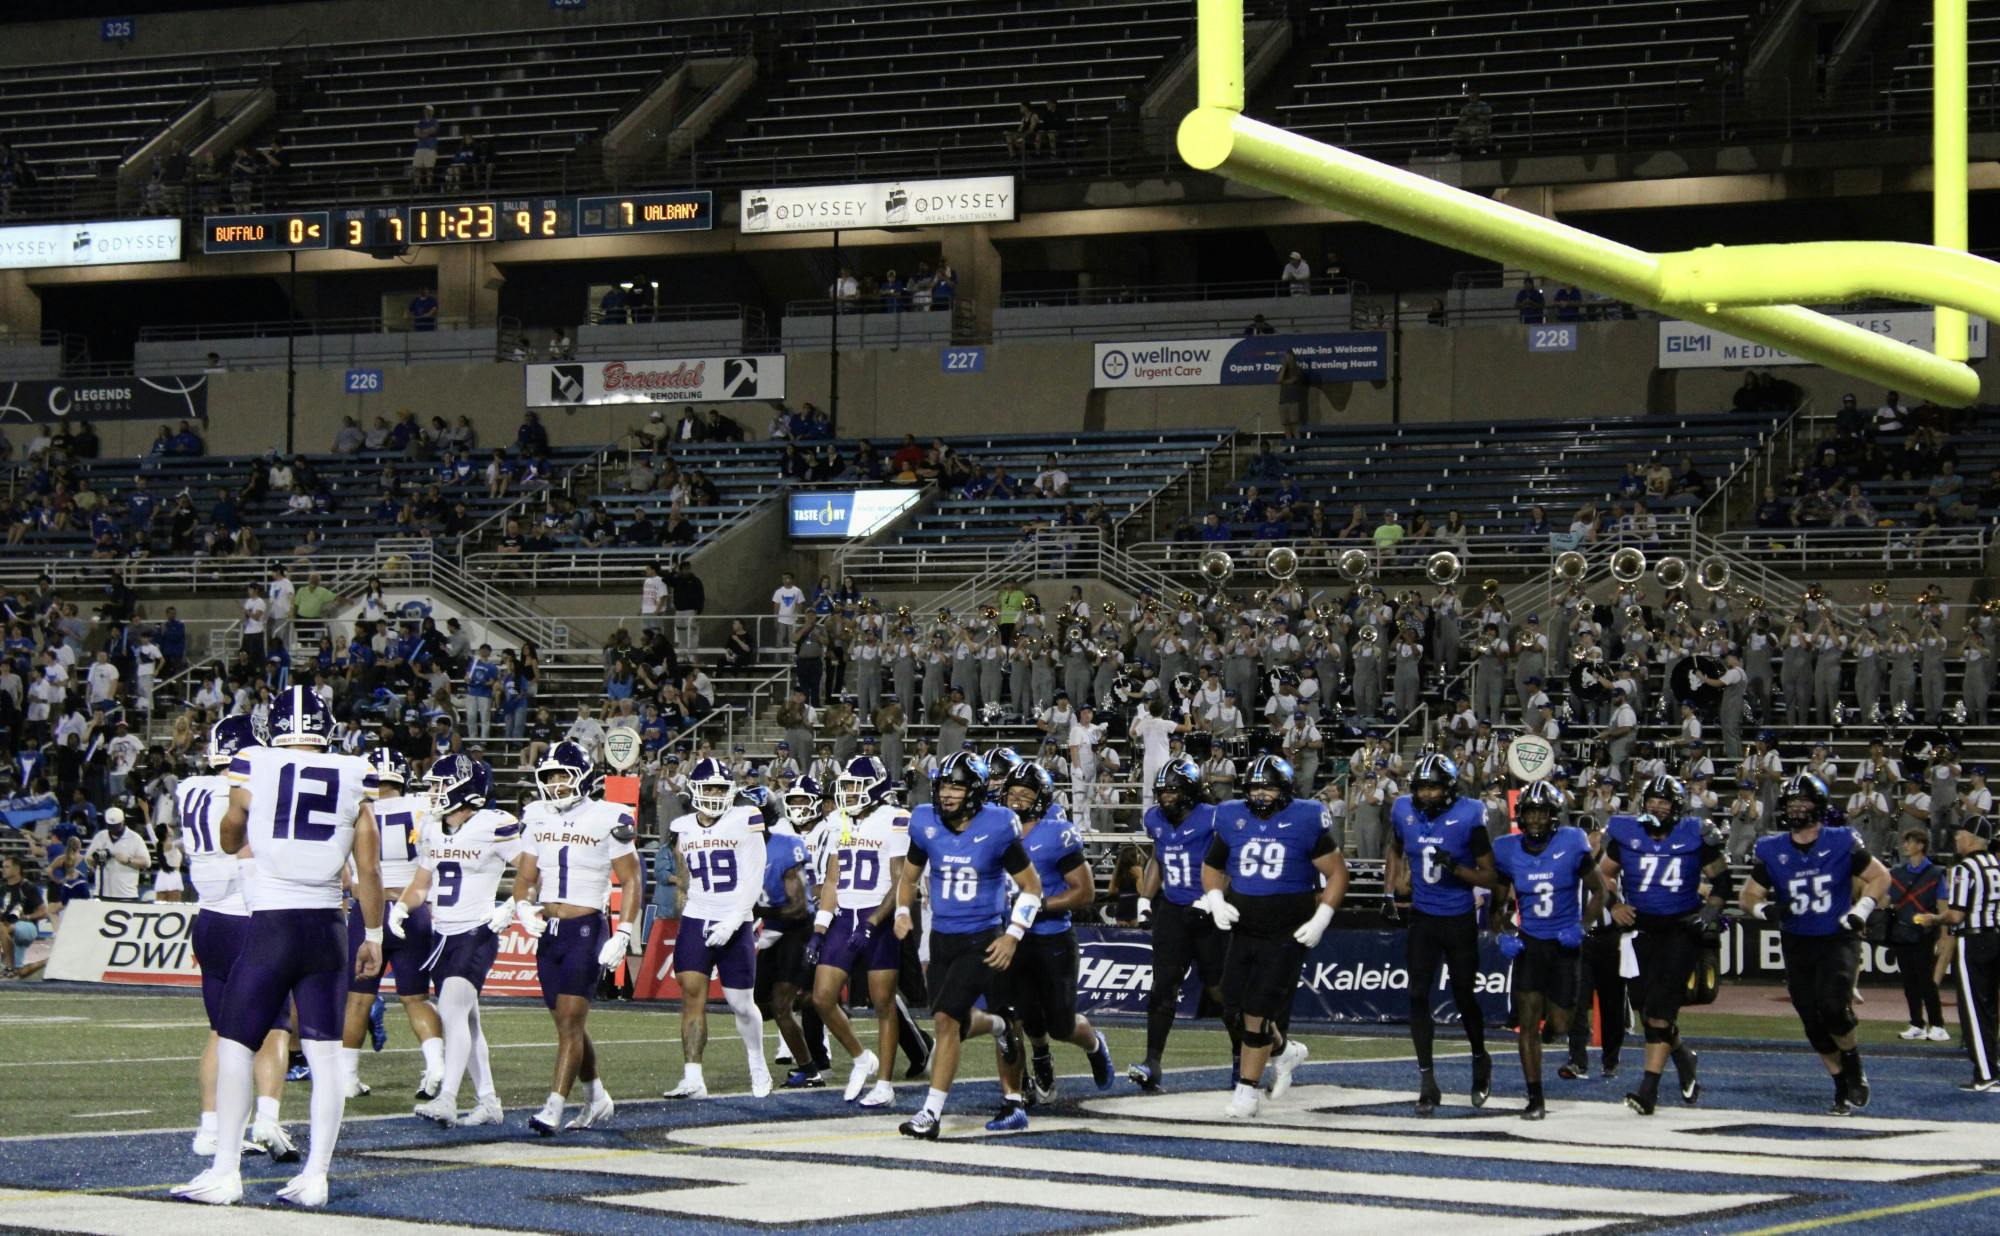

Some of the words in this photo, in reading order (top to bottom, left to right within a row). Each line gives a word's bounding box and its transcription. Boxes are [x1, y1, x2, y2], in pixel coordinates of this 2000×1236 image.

[106, 22, 130, 37] 325
[643, 203, 699, 221] UALBANY
[776, 200, 867, 220] ODYSSEY
[915, 193, 1009, 213] ODYSSEY
[420, 206, 493, 239] 11:23
[516, 211, 530, 234] 9
[542, 210, 556, 235] 2
[620, 202, 634, 225] 7
[215, 225, 264, 242] BUFFALO
[349, 220, 362, 244] 3
[389, 218, 402, 240] 7
[98, 235, 177, 253] ODYSSEY
[1536, 330, 1569, 347] 228
[1132, 347, 1211, 365] wellnow
[1292, 345, 1333, 355] Walk-ins
[1334, 344, 1378, 354] Welcome
[947, 352, 978, 369] 227
[1230, 363, 1255, 374] Open
[1255, 363, 1263, 372] 7
[1311, 360, 1349, 371] Evening
[1350, 358, 1378, 368] Hours
[350, 373, 378, 390] 226
[603, 360, 705, 391] Braendel
[1134, 366, 1173, 380] Urgent
[1175, 365, 1202, 377] Care
[74, 388, 132, 402] LEGENDS
[650, 391, 702, 400] REMODELING
[75, 402, 132, 412] GLOBAL
[794, 509, 818, 521] TASTE
[272, 763, 340, 841] 12
[837, 849, 880, 890] 20
[1164, 852, 1192, 888] 51
[1239, 841, 1286, 880] 69
[558, 845, 569, 899] 1
[687, 849, 738, 893] 49
[1638, 857, 1683, 893] 74
[437, 861, 464, 907] 9
[940, 865, 978, 901] 18
[1533, 881, 1554, 918] 3
[1788, 874, 1833, 915] 55
[1091, 991, 1128, 1000] NEW
